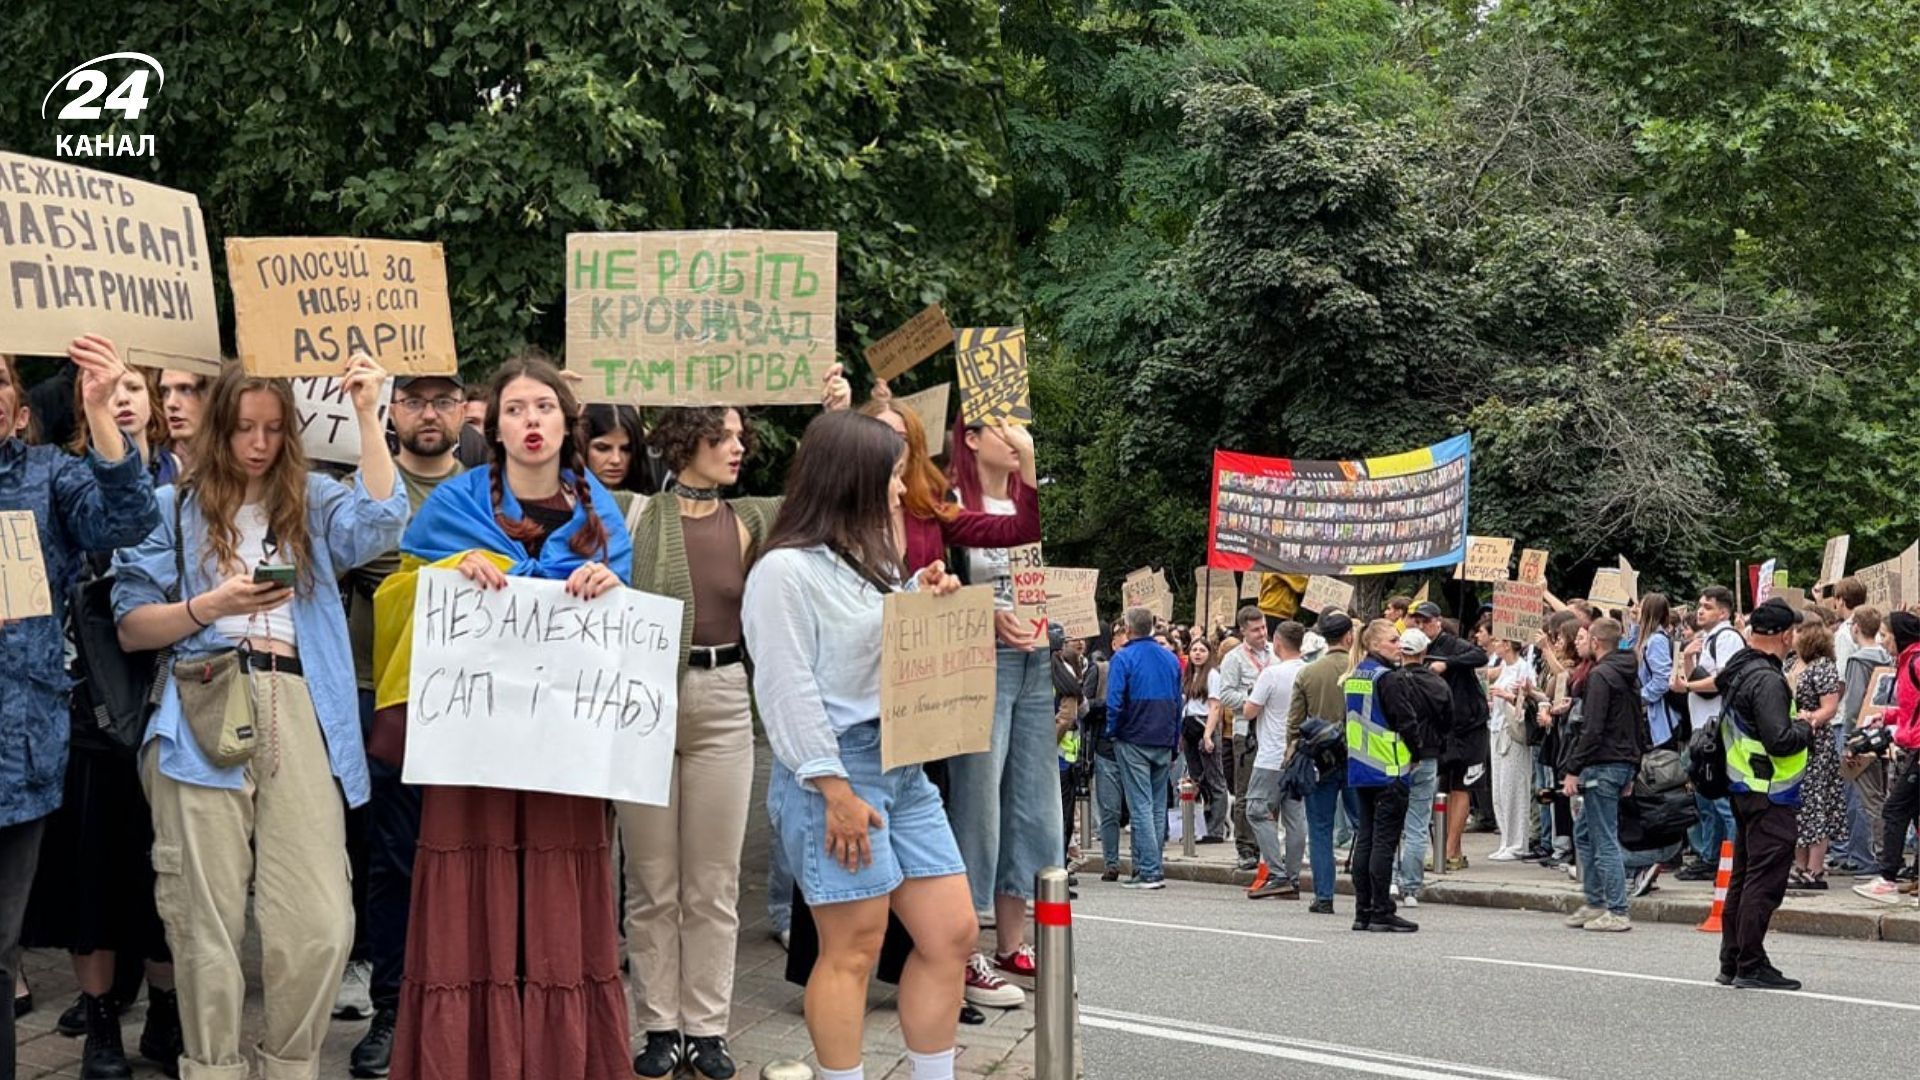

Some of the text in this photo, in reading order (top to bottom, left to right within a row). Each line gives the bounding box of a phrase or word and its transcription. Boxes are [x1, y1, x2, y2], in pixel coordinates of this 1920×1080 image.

[257, 245, 369, 289] ГОЛОСУЙ
[574, 246, 819, 300] НЕ РОБІТЬ
[590, 294, 697, 340] КРОК
[294, 322, 427, 363] ASAP!!!
[592, 355, 676, 396] ТАМ
[936, 608, 988, 644] ТРЕБА
[417, 667, 494, 725] САП
[574, 669, 665, 737] НАБУ
